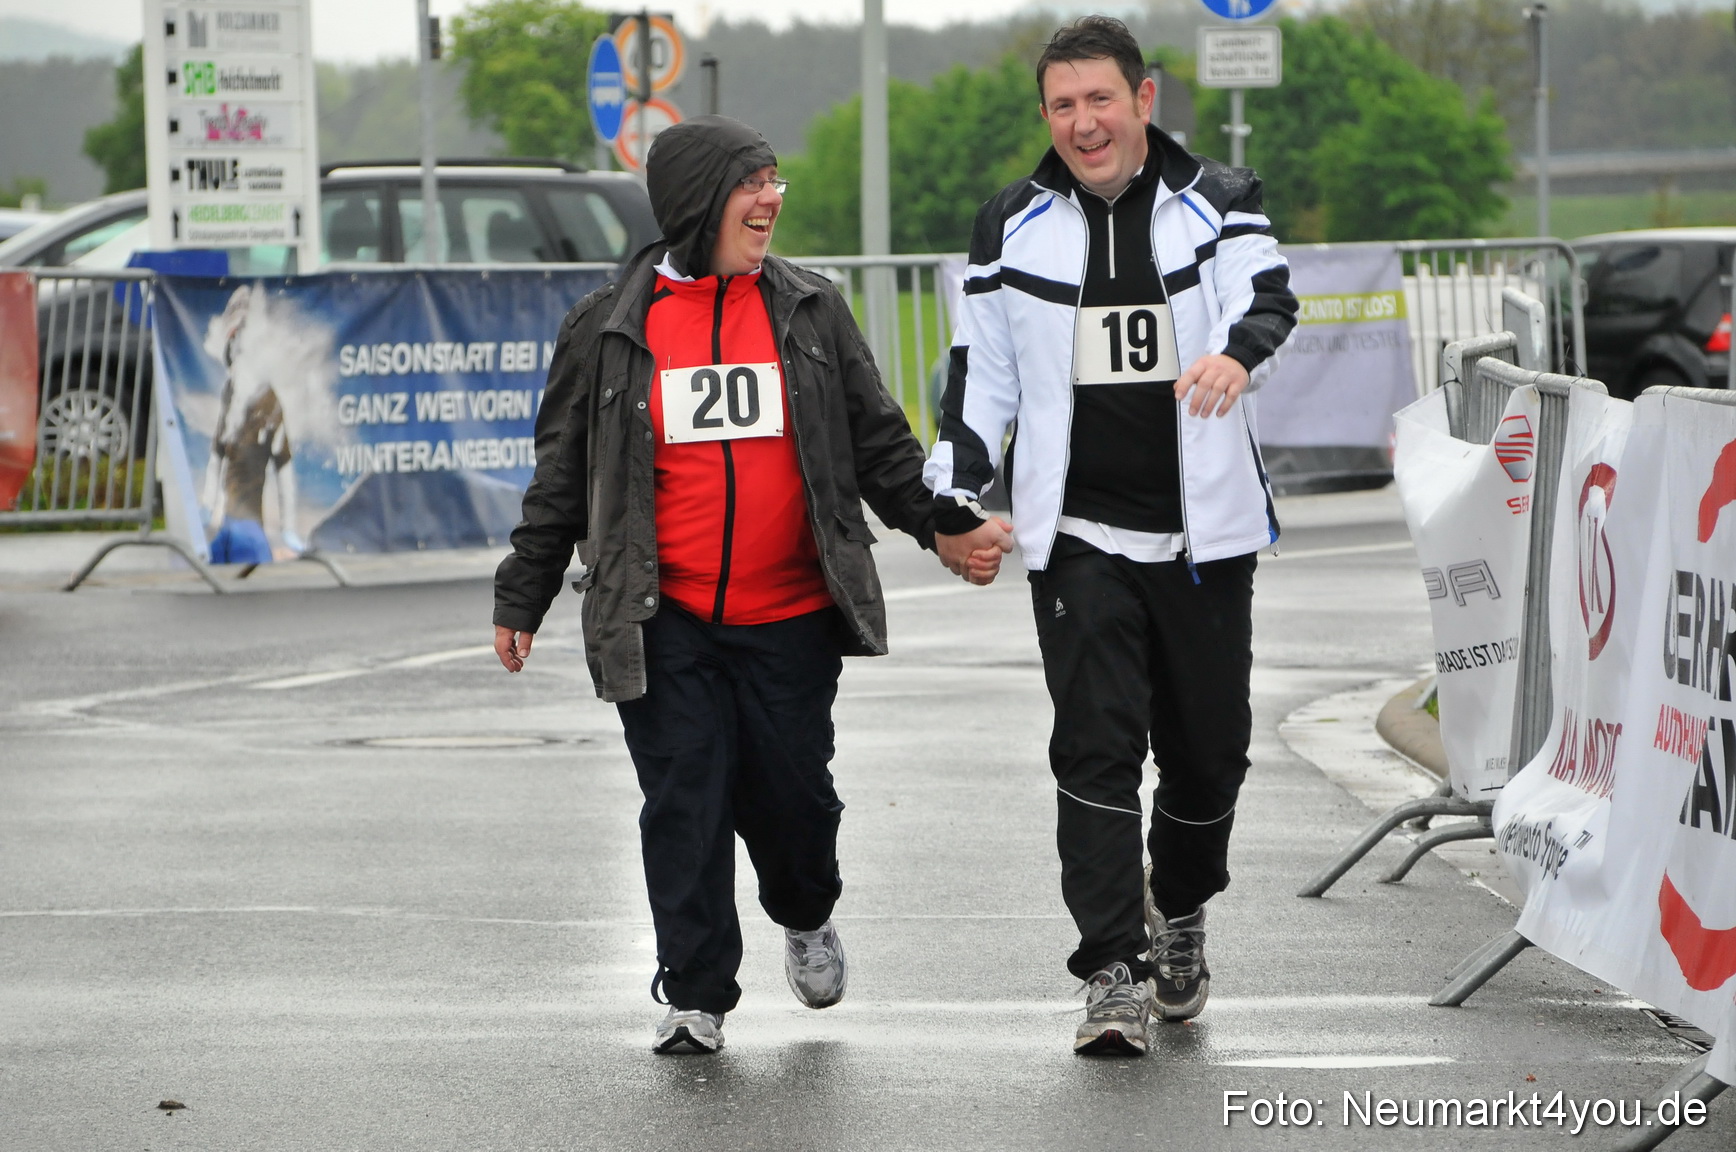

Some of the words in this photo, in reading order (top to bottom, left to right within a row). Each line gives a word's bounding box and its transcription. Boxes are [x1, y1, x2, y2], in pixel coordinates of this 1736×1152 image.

[187, 158, 239, 191] THULE
[338, 341, 497, 377] SAISONSTART
[499, 340, 538, 374] BEI
[1101, 309, 1159, 373] 19
[337, 391, 410, 426] GANZ
[467, 388, 533, 422] VORN
[690, 366, 761, 430] 20
[1467, 643, 1493, 668] IST
